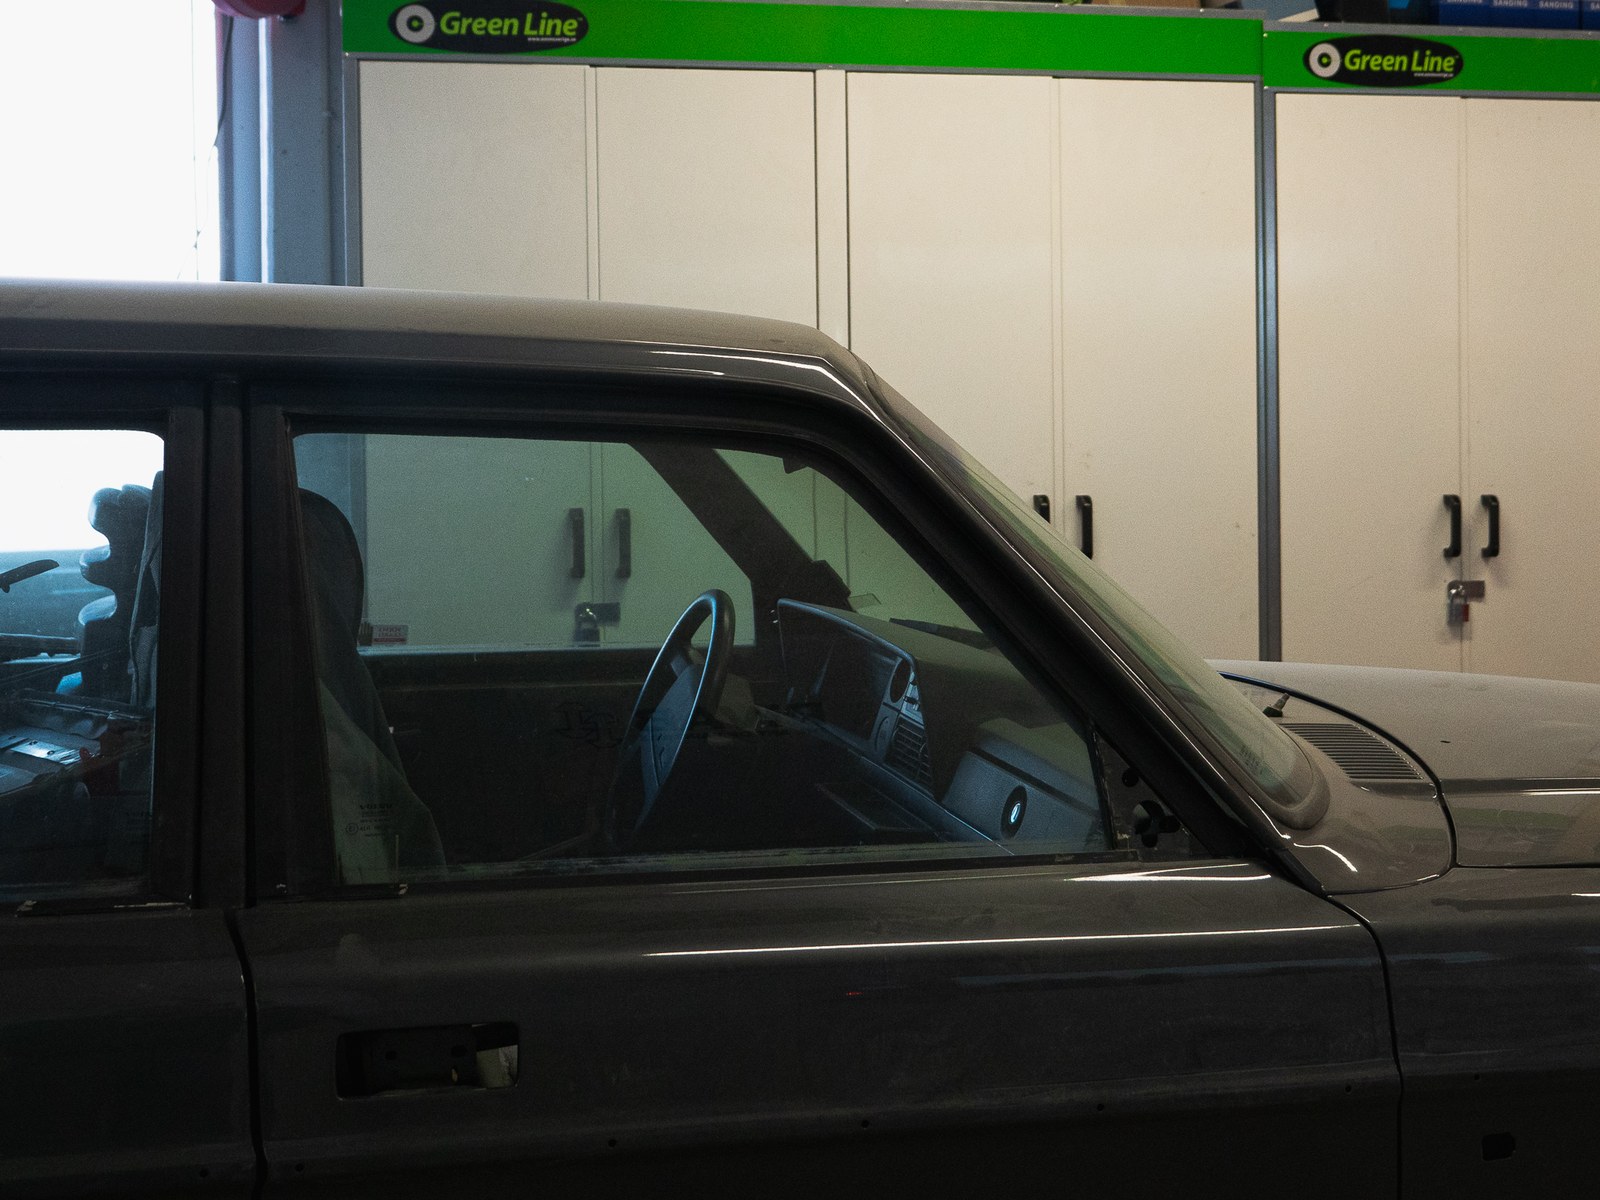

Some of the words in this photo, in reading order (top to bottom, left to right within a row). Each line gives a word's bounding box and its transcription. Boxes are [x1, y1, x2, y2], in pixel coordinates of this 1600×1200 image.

[1538, 1, 1574, 9] SANDING
[440, 11, 519, 35] Green
[523, 11, 578, 36] Line
[1344, 49, 1408, 71] Green
[1411, 49, 1455, 72] Line
